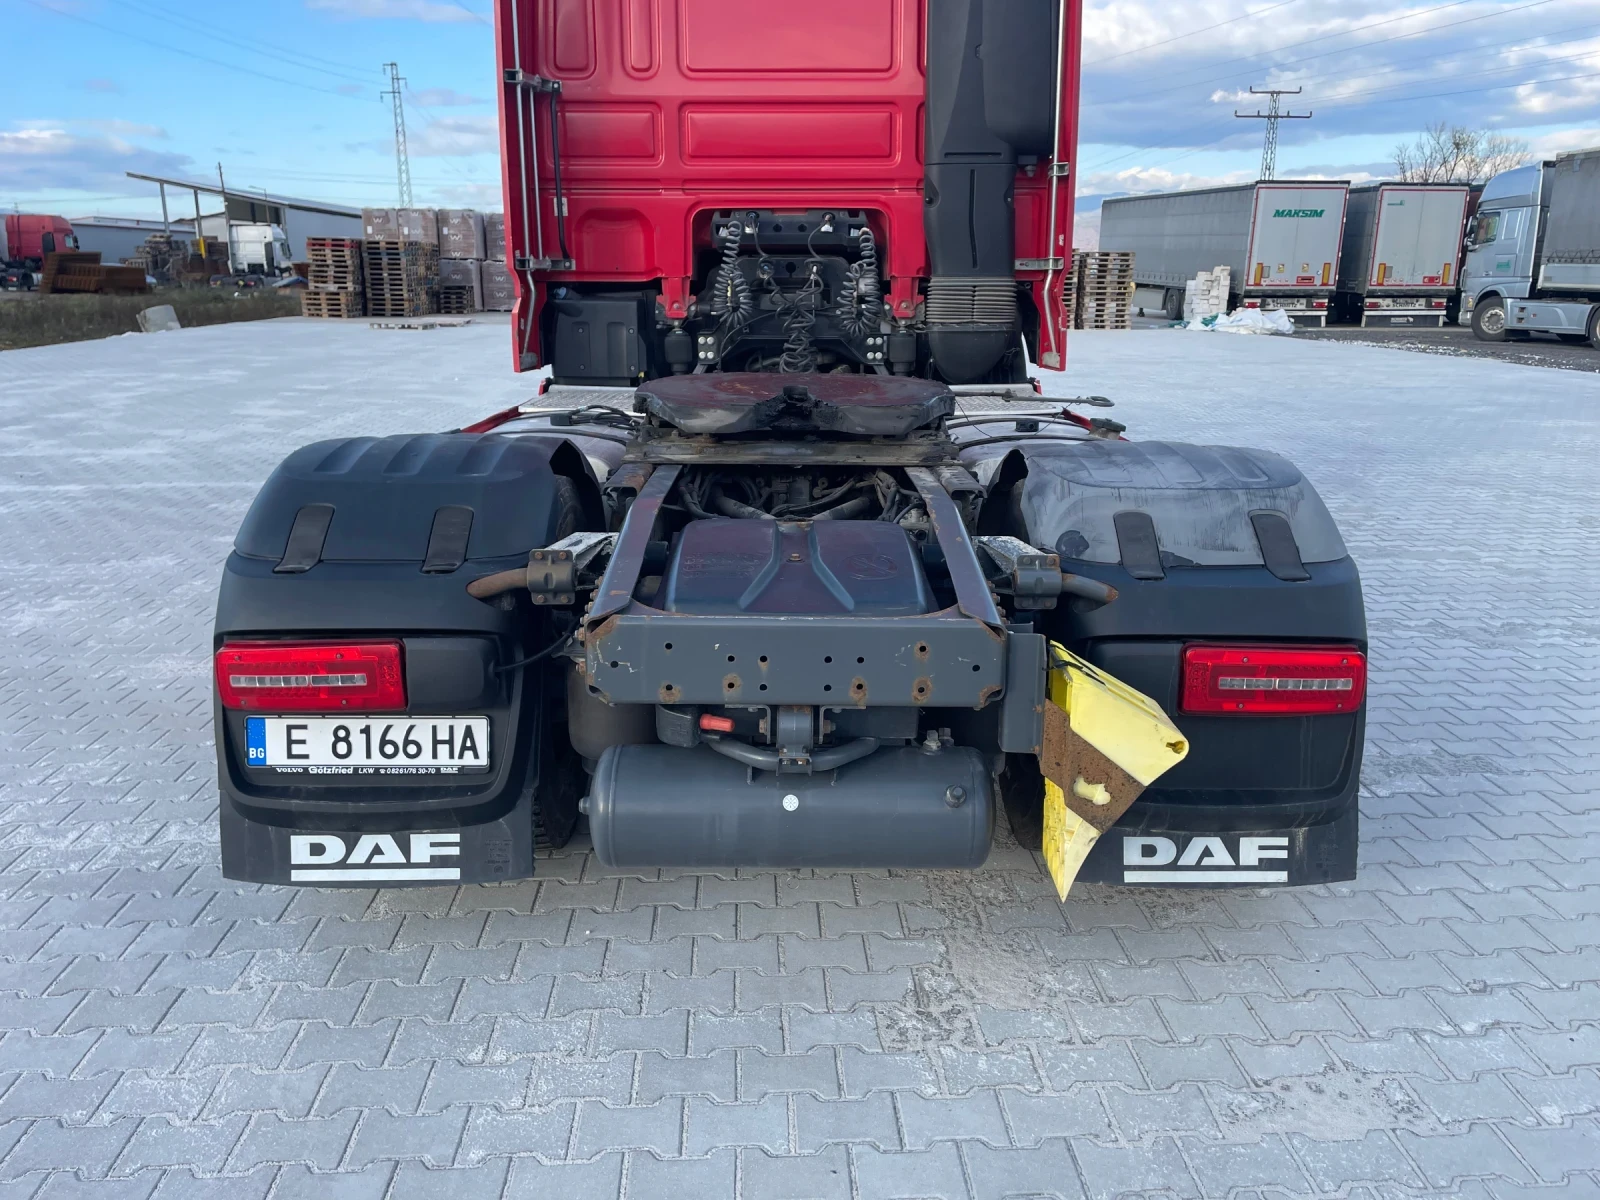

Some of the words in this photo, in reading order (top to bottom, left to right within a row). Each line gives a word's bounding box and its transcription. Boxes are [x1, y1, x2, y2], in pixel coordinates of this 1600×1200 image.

[1273, 209, 1325, 218] MAKSIM
[249, 747, 265, 759] BG
[286, 724, 310, 760] E
[290, 833, 461, 865] DAF
[1122, 836, 1289, 867] DAF
